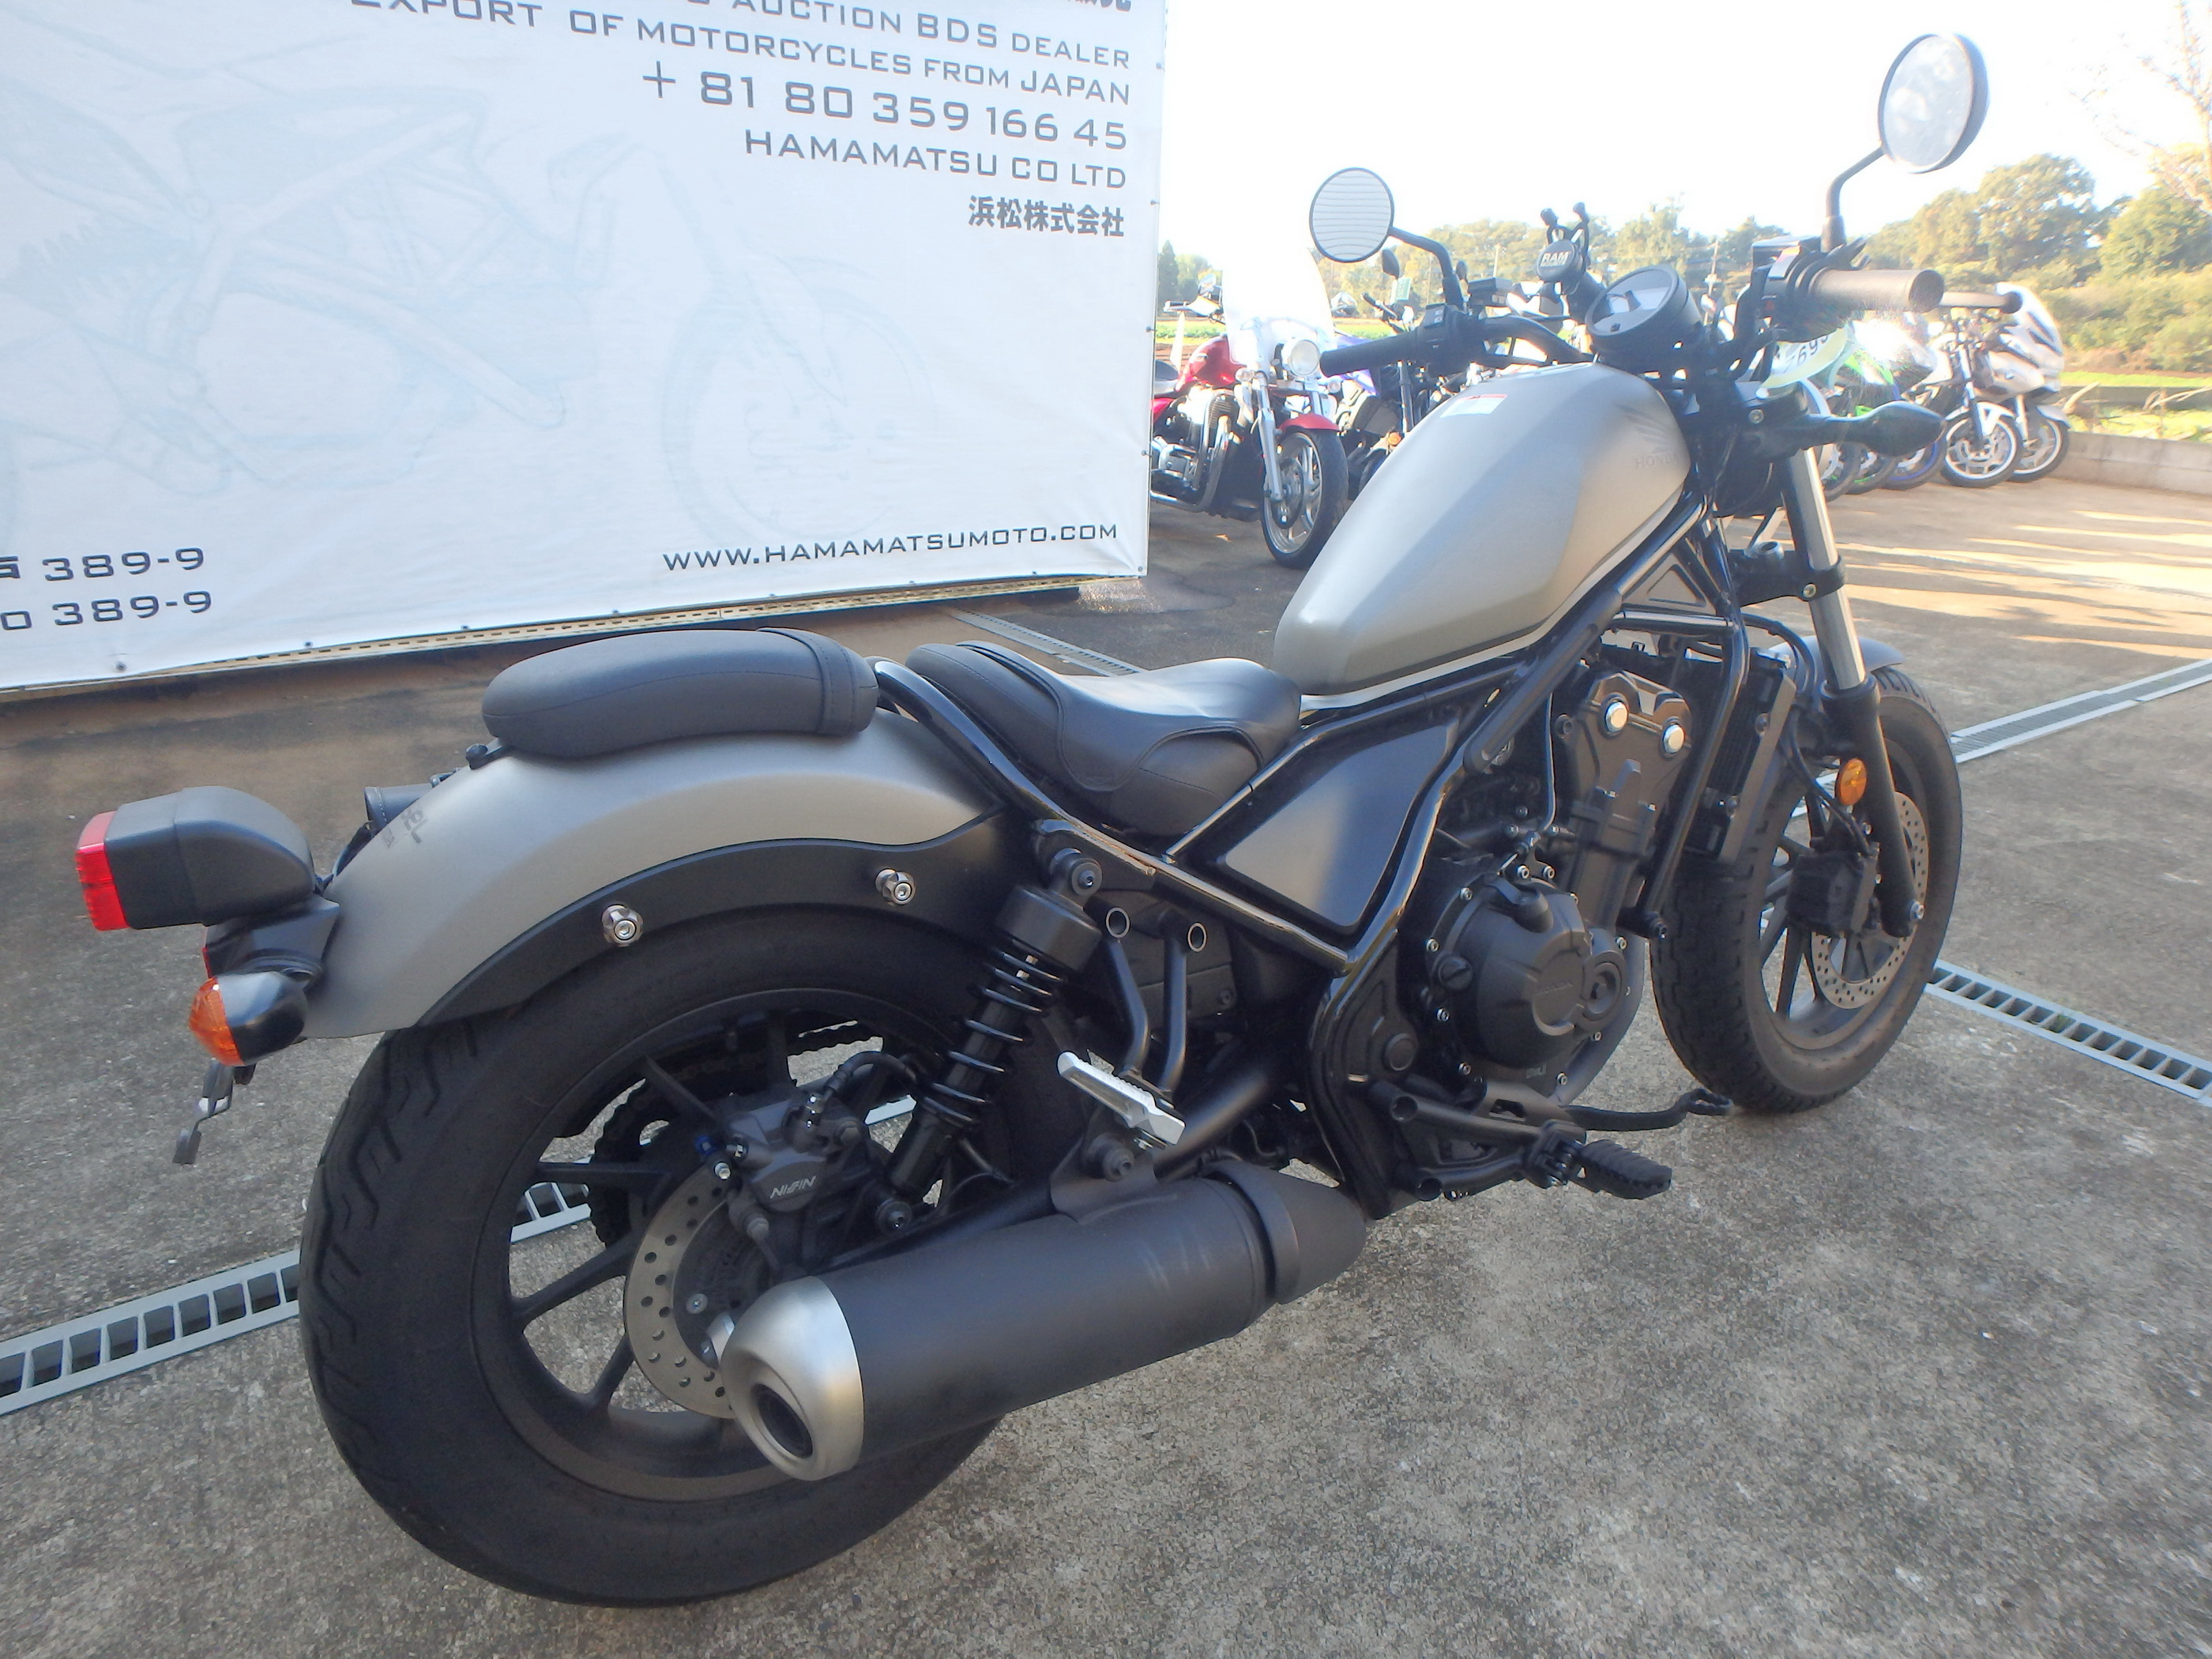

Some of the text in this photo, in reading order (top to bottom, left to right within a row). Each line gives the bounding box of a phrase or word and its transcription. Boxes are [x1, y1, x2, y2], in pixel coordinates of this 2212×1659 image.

[570, 10, 623, 36] OF
[638, 19, 911, 75] MOTORCYCLES
[925, 58, 1008, 88] FROM
[1021, 70, 1129, 105] JAPAN
[918, 13, 997, 48] BDS
[1012, 33, 1129, 70] DEALER
[701, 71, 754, 108] 81
[785, 81, 853, 119] 80
[873, 92, 969, 131] 359
[986, 107, 1058, 142] 166
[1074, 119, 1127, 149] 45
[746, 130, 1126, 189] HAMAMATSU CO LTD
[969, 195, 1124, 237] 浜松株式会社
[1541, 251, 1569, 262] RAM
[42, 547, 205, 581] 389-9
[663, 524, 1116, 570] WWW.HAMAMATSUMOTO.COM
[52, 591, 212, 626] 389-9
